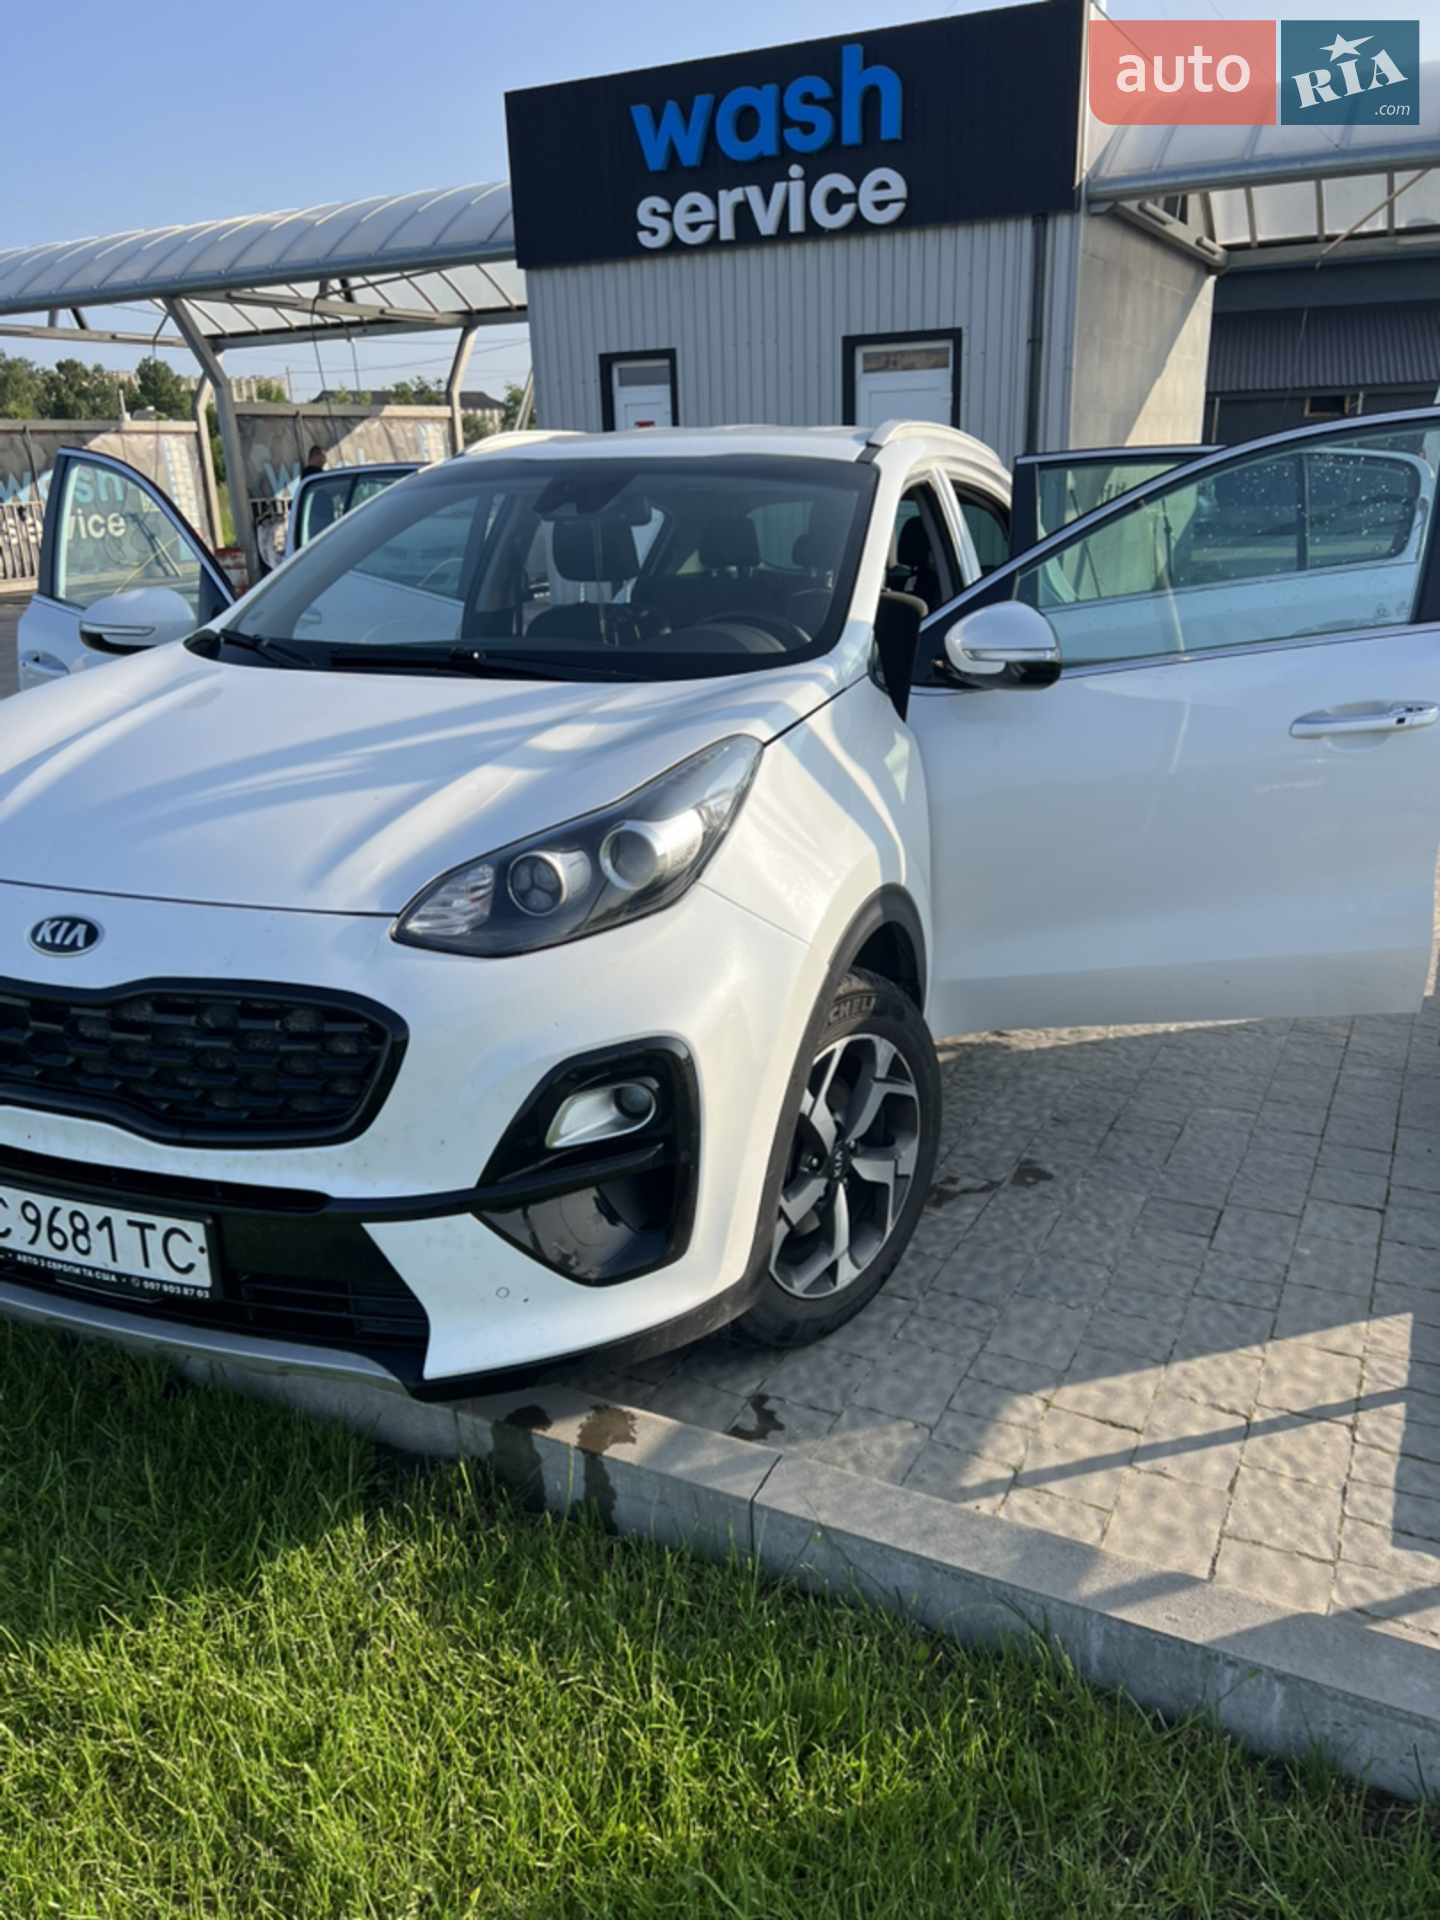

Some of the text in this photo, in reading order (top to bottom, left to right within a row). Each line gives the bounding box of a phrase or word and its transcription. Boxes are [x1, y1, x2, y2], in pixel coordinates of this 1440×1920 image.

[630, 43, 902, 171] wash
[636, 163, 907, 249] service
[36, 920, 87, 948] KIA
